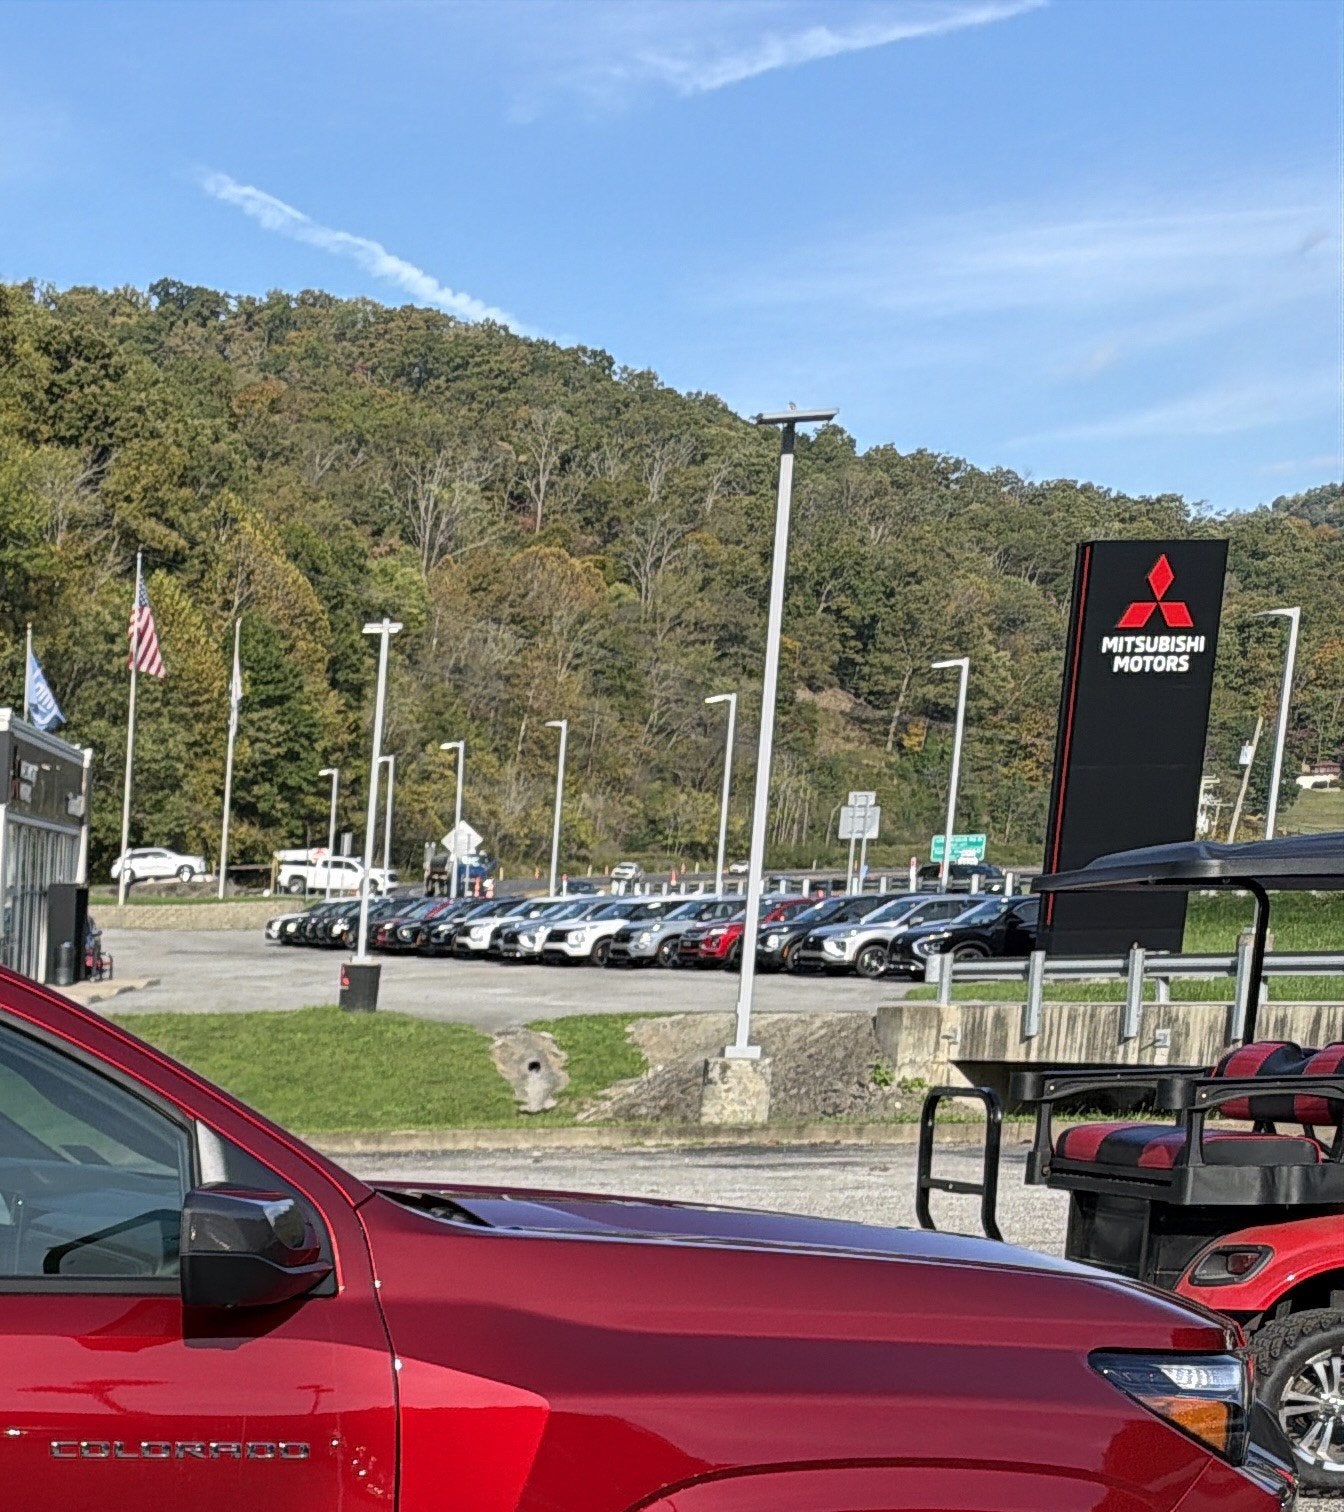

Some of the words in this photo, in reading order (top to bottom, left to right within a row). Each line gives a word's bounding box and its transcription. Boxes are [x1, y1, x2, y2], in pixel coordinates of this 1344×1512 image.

[1101, 635, 1206, 654] MITSUBISHI
[1112, 654, 1190, 673] MOTORS
[49, 1440, 311, 1460] COLORADO
